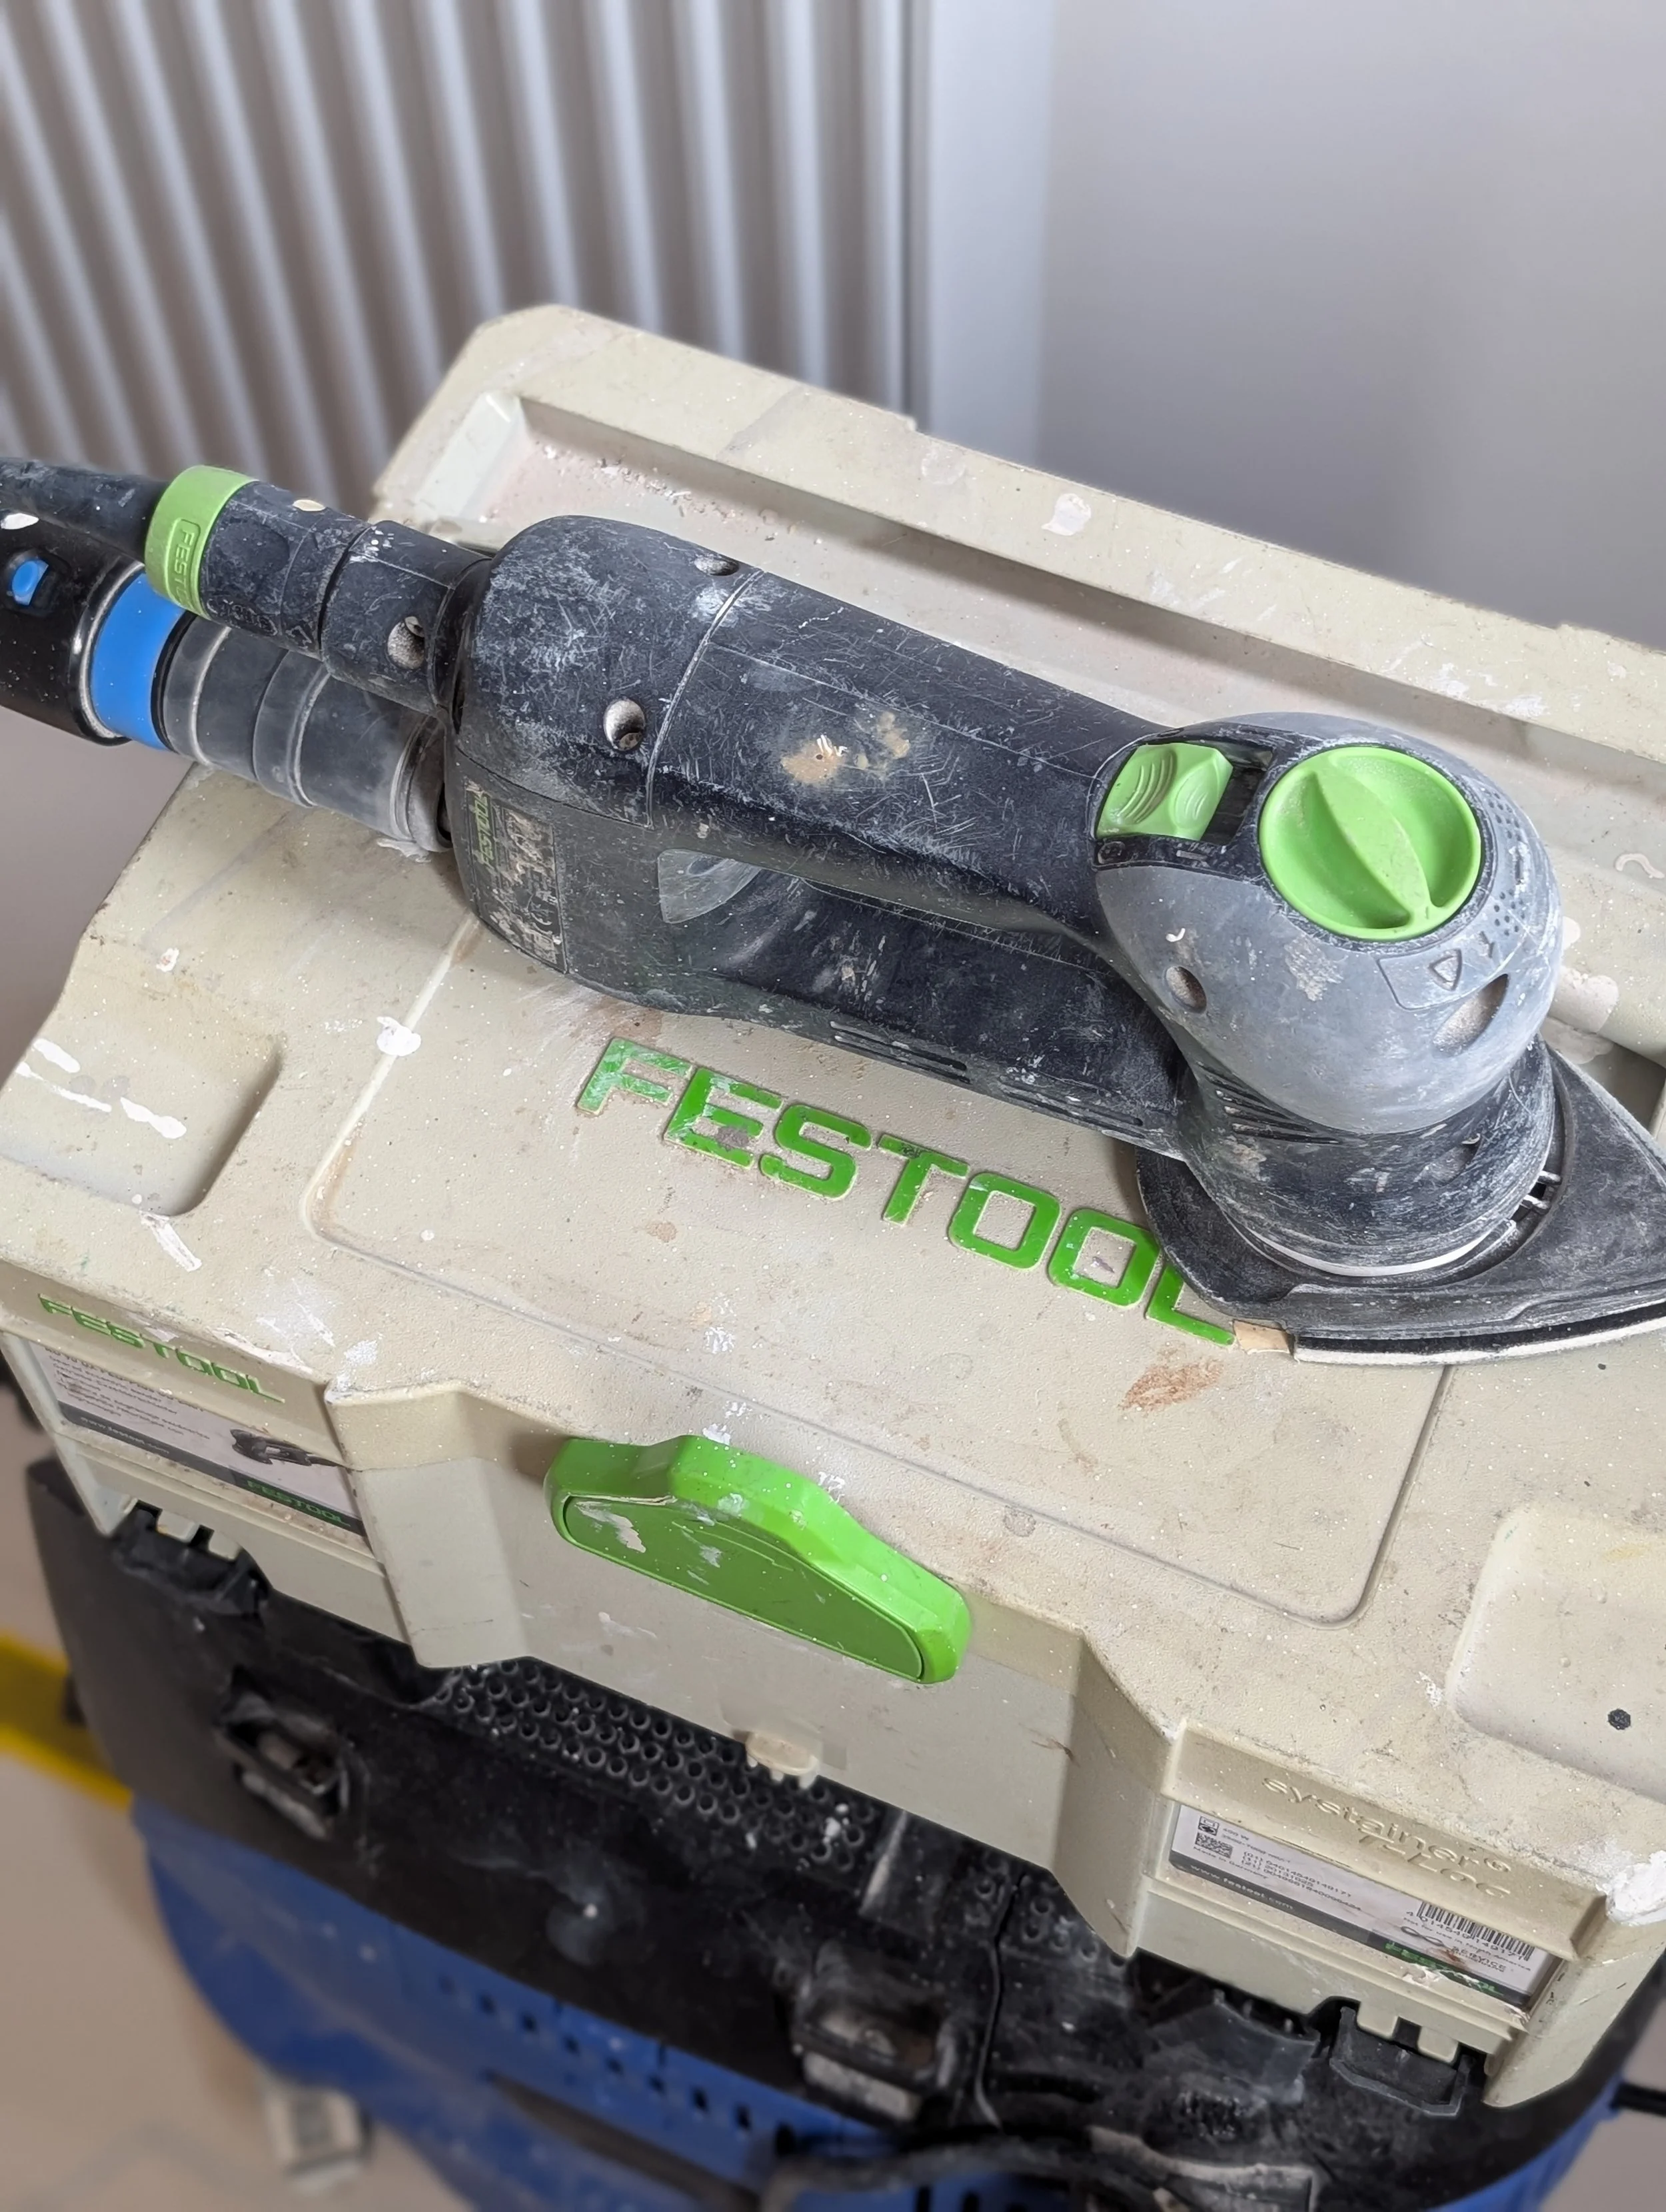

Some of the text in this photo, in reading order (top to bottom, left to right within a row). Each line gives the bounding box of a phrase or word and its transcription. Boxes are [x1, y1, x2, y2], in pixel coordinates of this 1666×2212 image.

[575, 1037, 1235, 1347] FESTOOL
[38, 1293, 285, 1404] FESTOOL
[247, 1480, 351, 1527] FESTOOL
